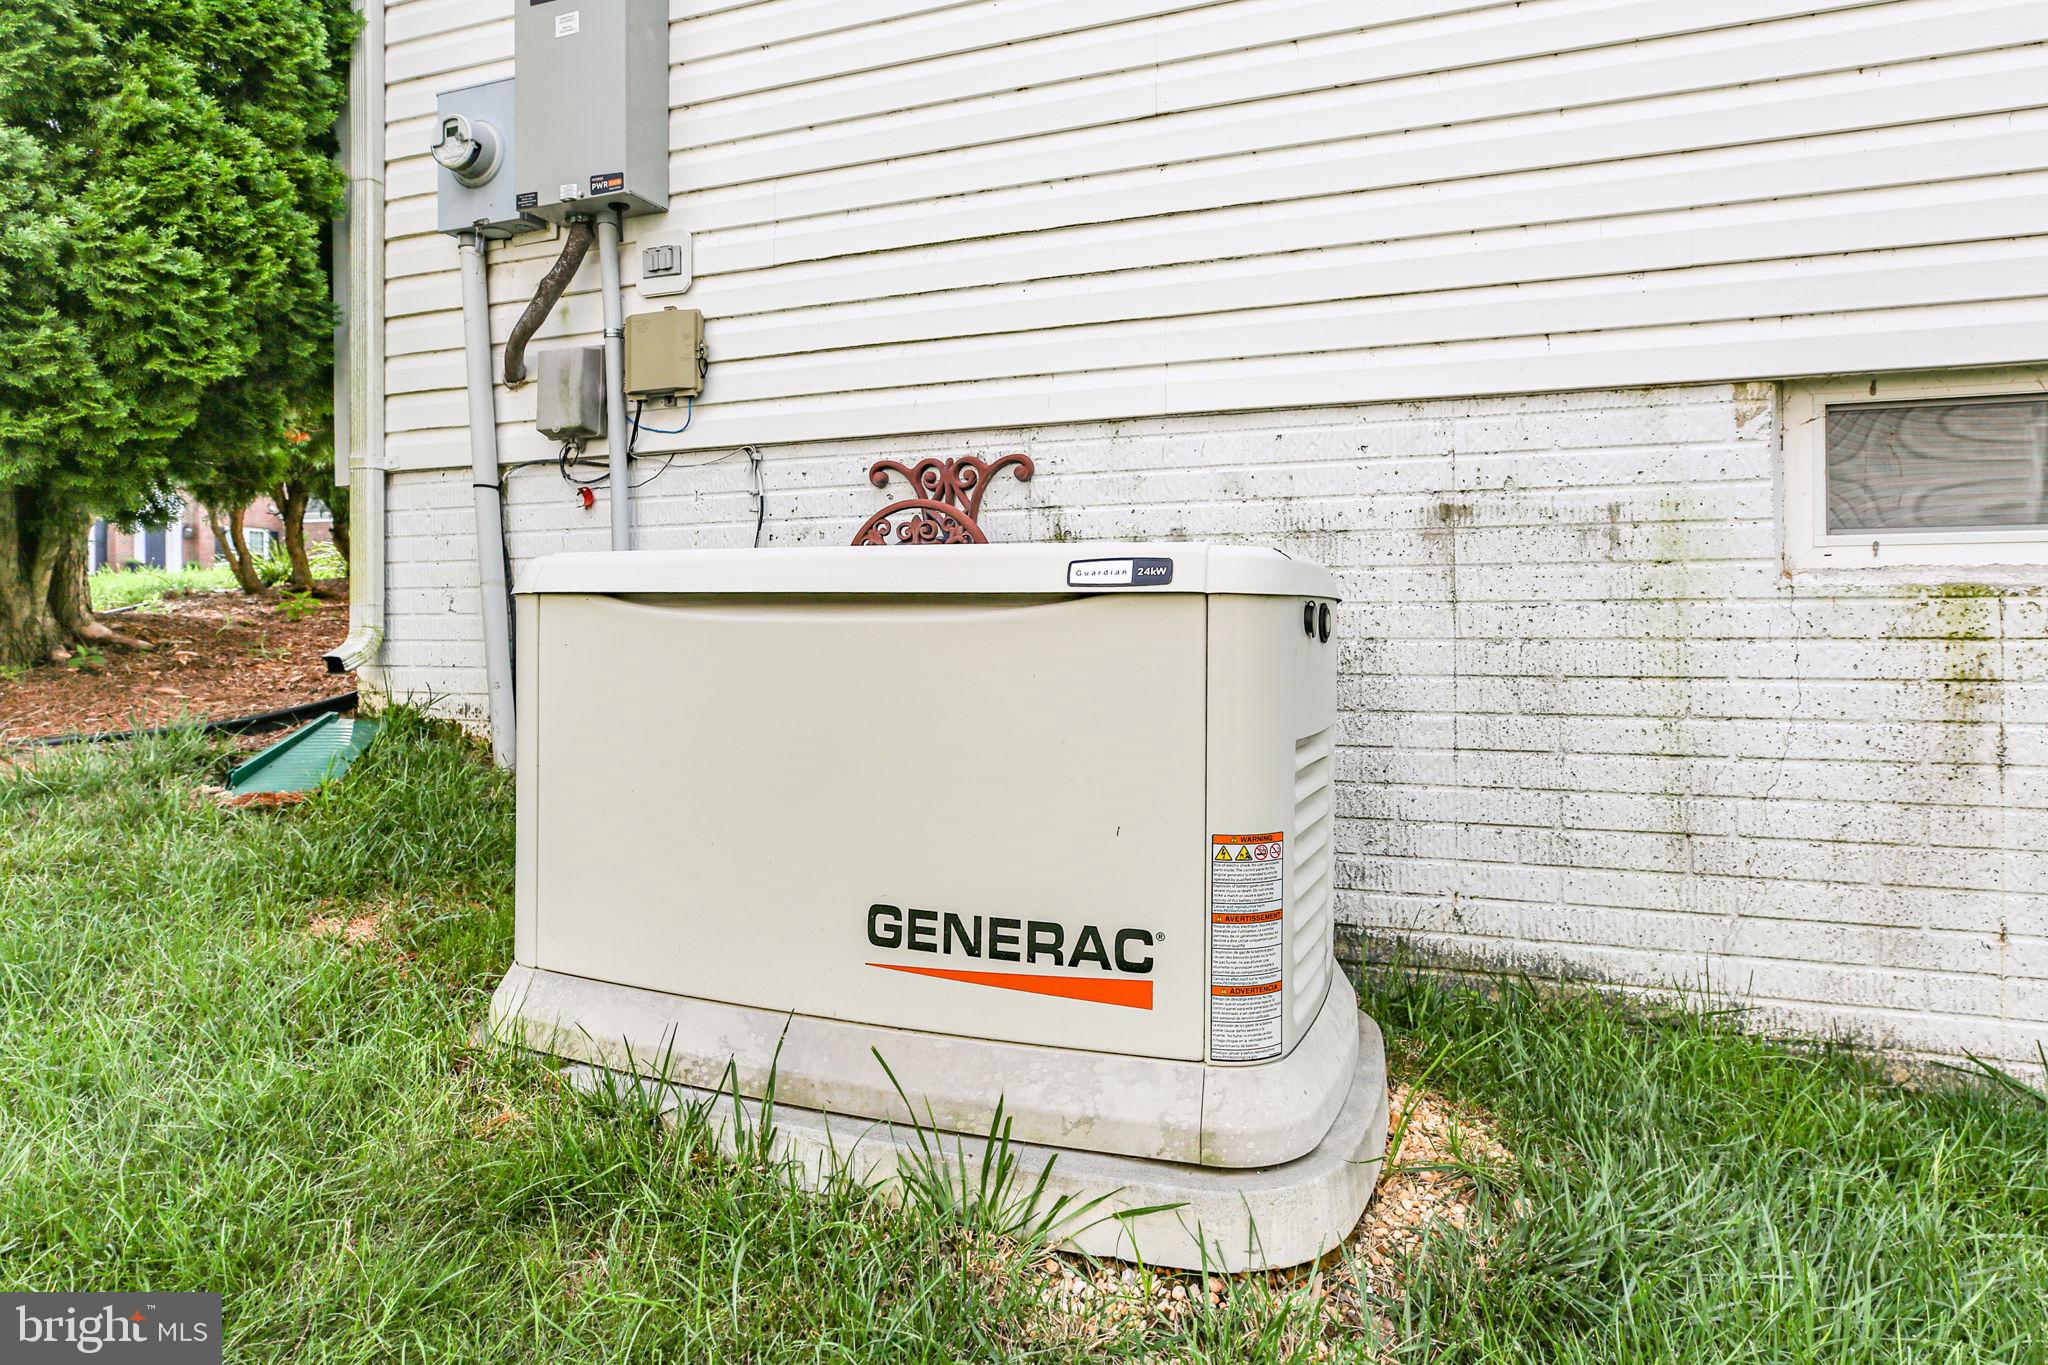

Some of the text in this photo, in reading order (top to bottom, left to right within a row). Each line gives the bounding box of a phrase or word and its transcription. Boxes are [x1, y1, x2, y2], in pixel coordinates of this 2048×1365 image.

[1075, 567, 1168, 577] Guardian 24kW
[1225, 912, 1281, 922] AVERTISSEMENT
[1230, 984, 1278, 994] ADVERTENCIA
